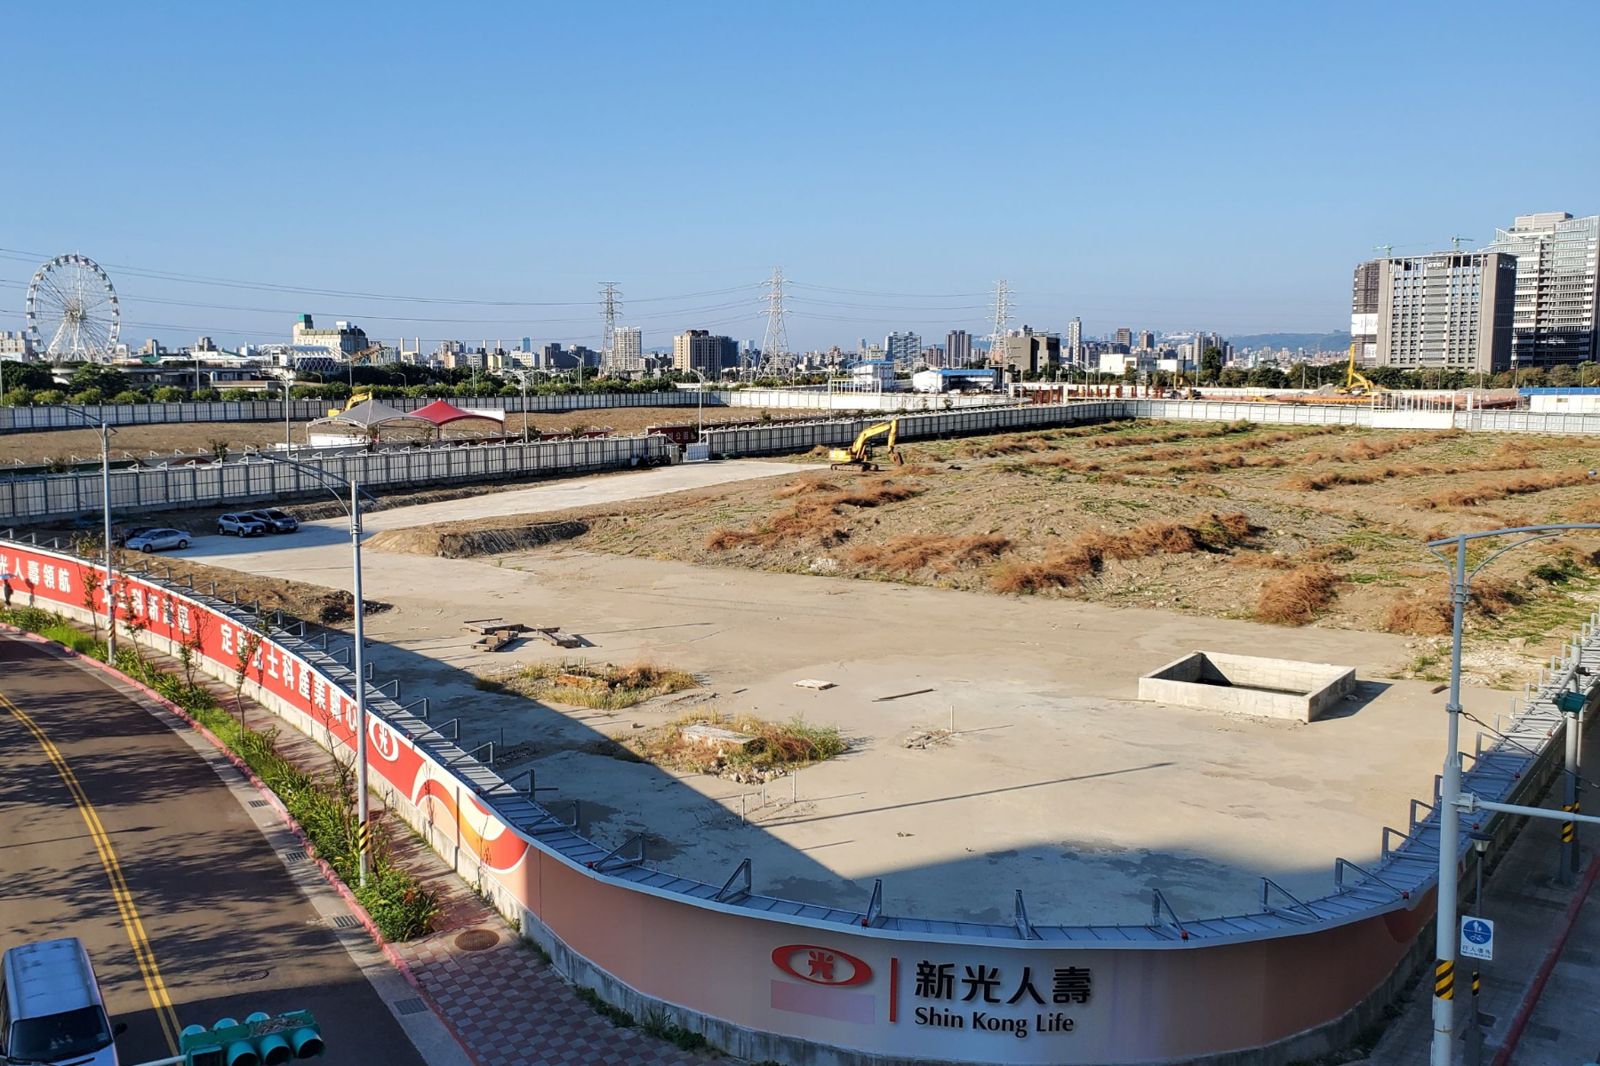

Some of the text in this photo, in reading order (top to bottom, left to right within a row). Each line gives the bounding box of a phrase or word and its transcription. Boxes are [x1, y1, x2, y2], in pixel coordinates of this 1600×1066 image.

[914, 960, 1092, 1005] 新光人壽
[914, 1007, 1075, 1038] Shin Kong Life
